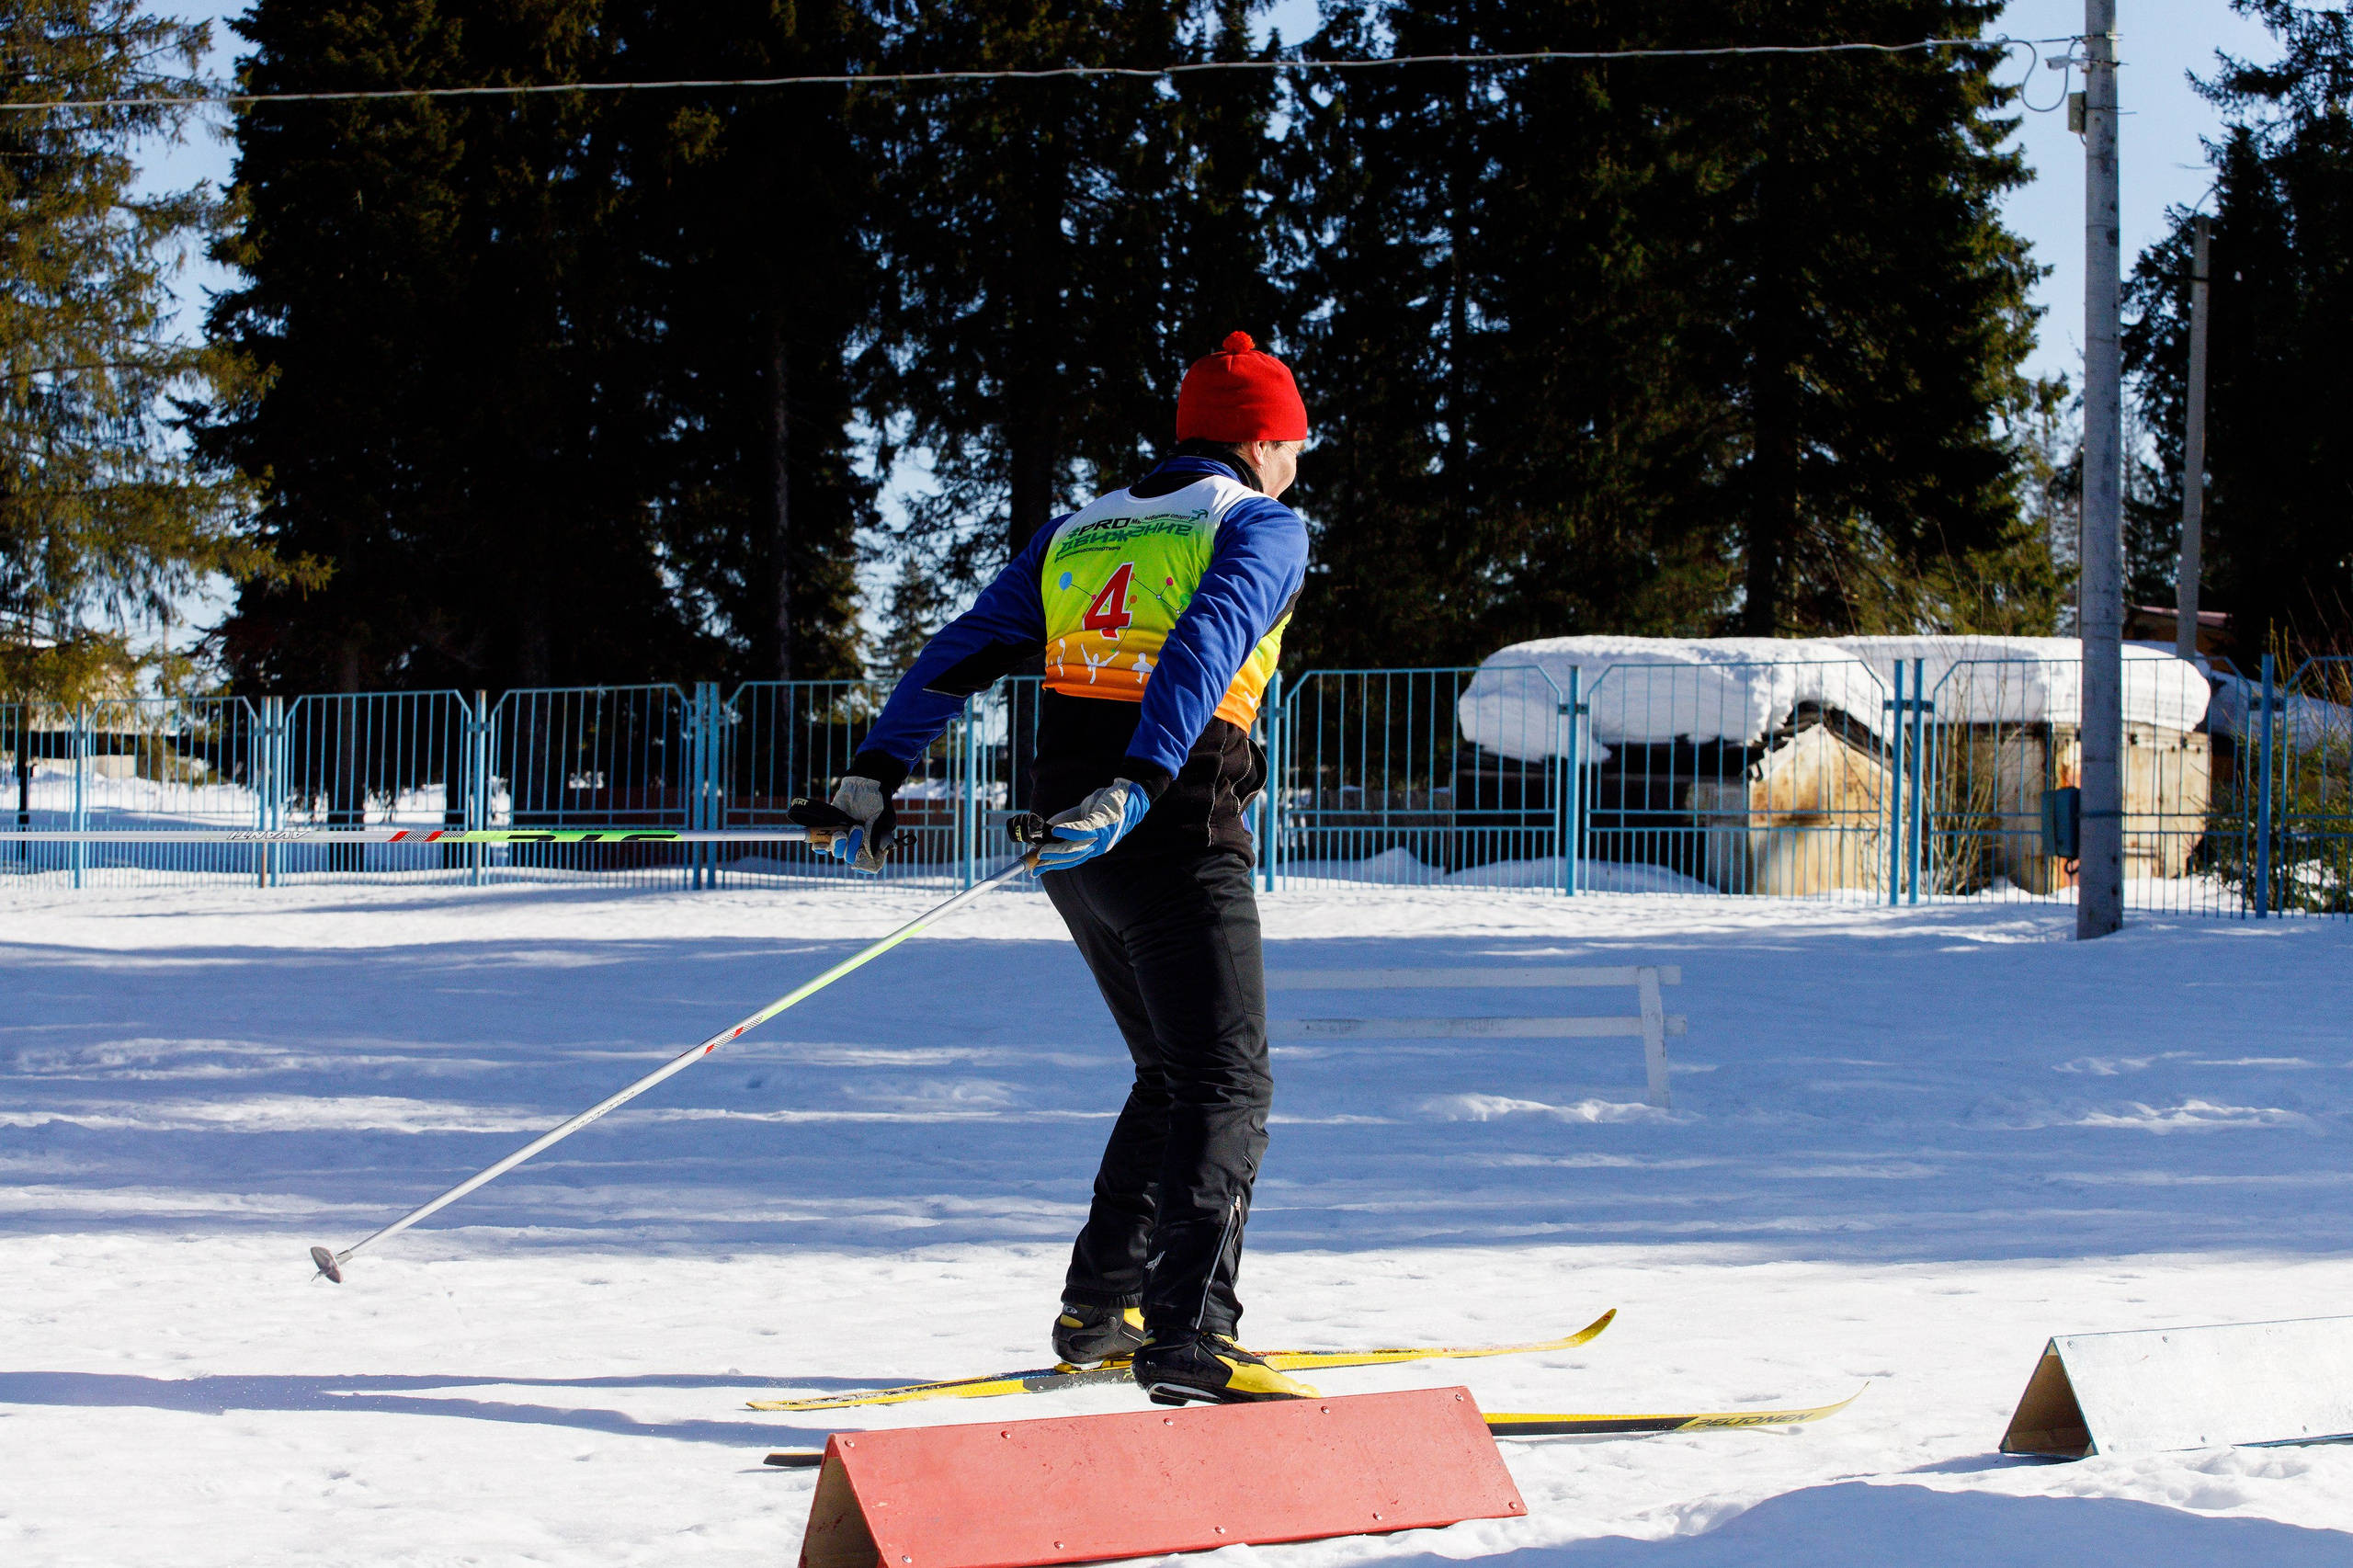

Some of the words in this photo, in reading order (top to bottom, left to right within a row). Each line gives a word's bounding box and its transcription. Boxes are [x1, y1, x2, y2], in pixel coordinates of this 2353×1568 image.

[1082, 562, 1134, 641] 4
[226, 830, 311, 840] AVANTI
[1692, 1413, 1815, 1427] PELTONEN
